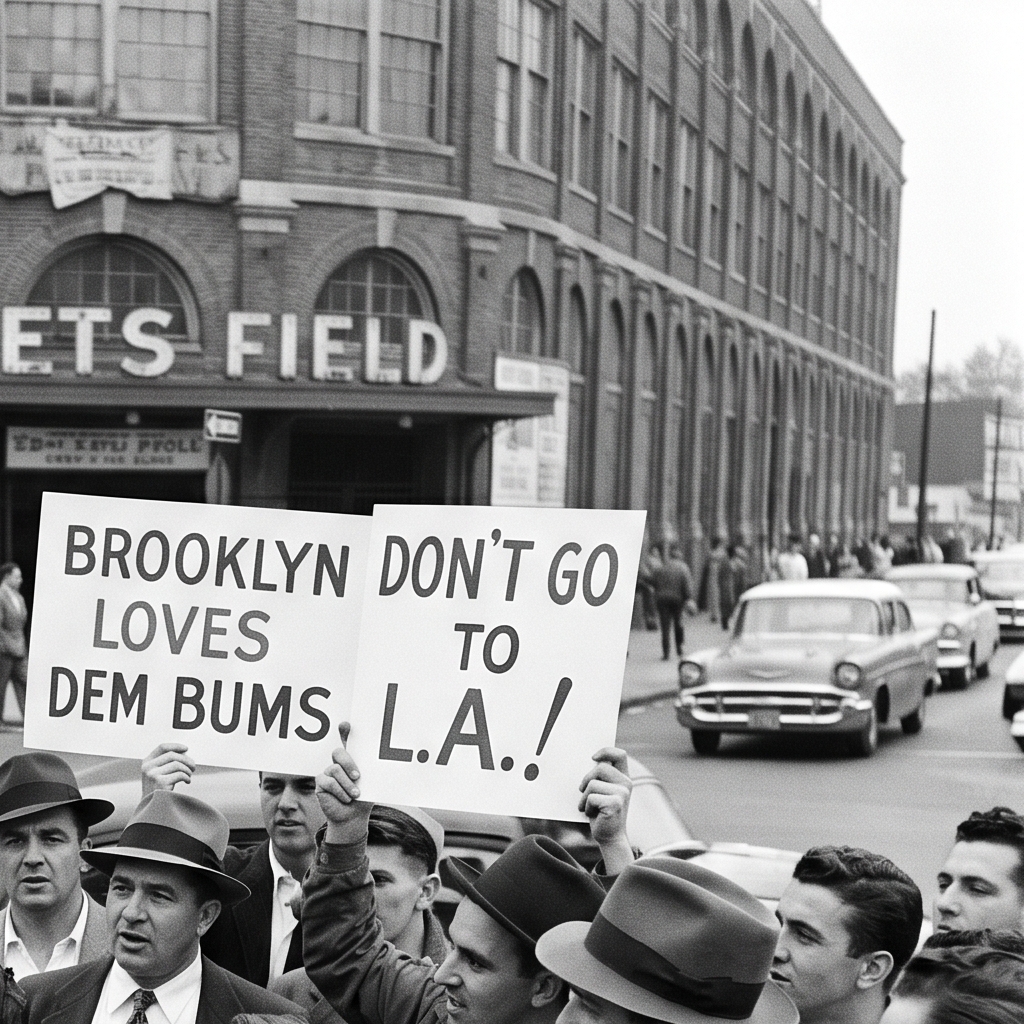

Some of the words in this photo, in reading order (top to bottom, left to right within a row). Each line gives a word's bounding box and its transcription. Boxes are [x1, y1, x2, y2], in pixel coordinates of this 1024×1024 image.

[226, 312, 448, 385] FIELD
[64, 525, 350, 598] BROOKLYN
[379, 528, 534, 601] DON'T
[548, 542, 619, 607] GO
[94, 599, 270, 662] LOVES
[454, 623, 520, 674] TO
[48, 666, 148, 726] DEM
[172, 676, 331, 742] BUMS
[379, 677, 573, 781] L.A.!
